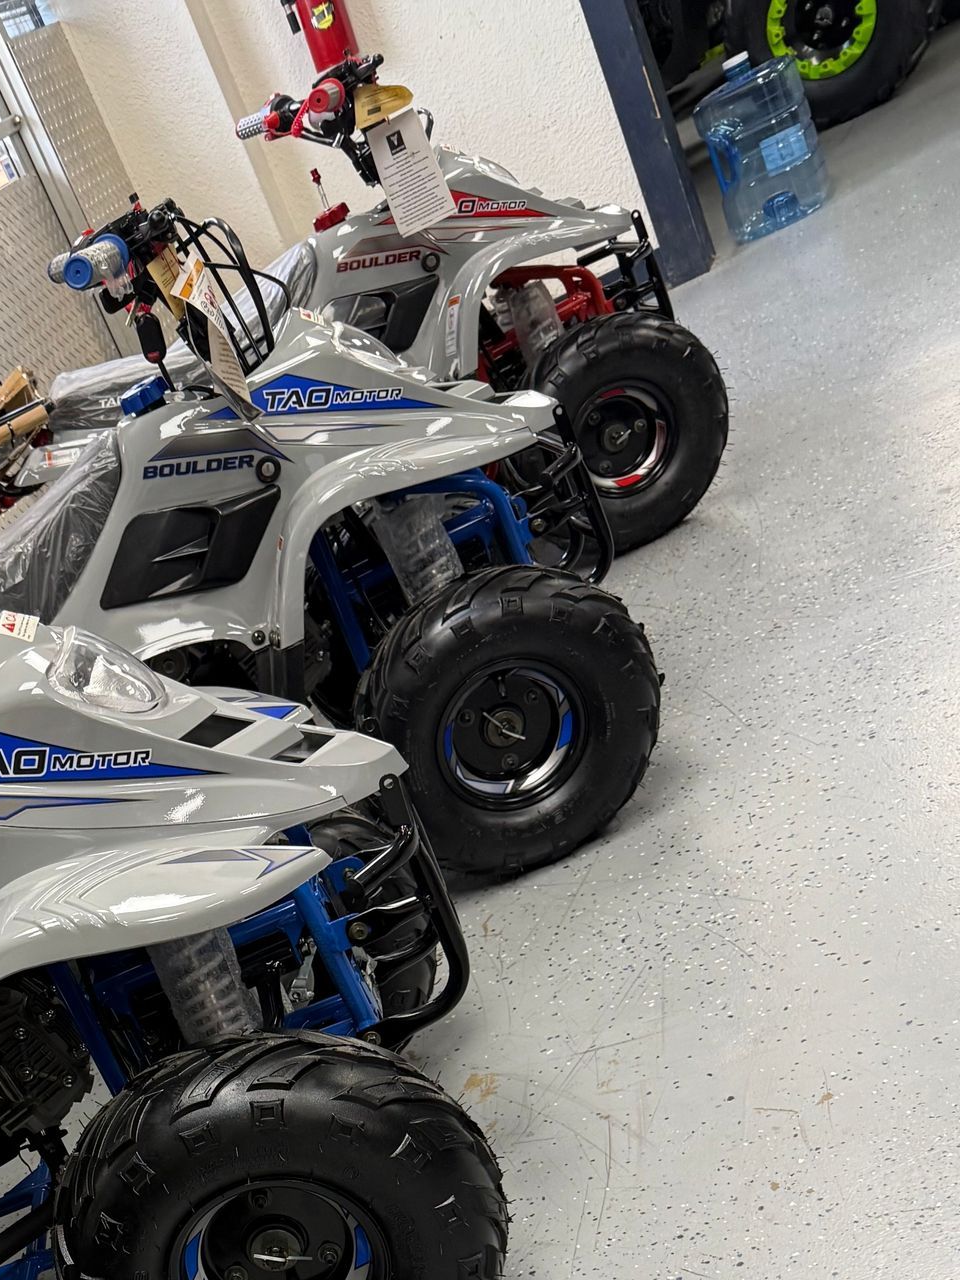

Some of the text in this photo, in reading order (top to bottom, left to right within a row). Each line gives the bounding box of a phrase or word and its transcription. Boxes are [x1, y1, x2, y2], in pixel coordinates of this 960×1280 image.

[478, 199, 528, 211] MOTOR
[336, 249, 421, 273] BOULDER
[263, 386, 404, 411] TAO MOTOR
[143, 455, 254, 480] BOULDER
[50, 749, 152, 771] MOTOR
